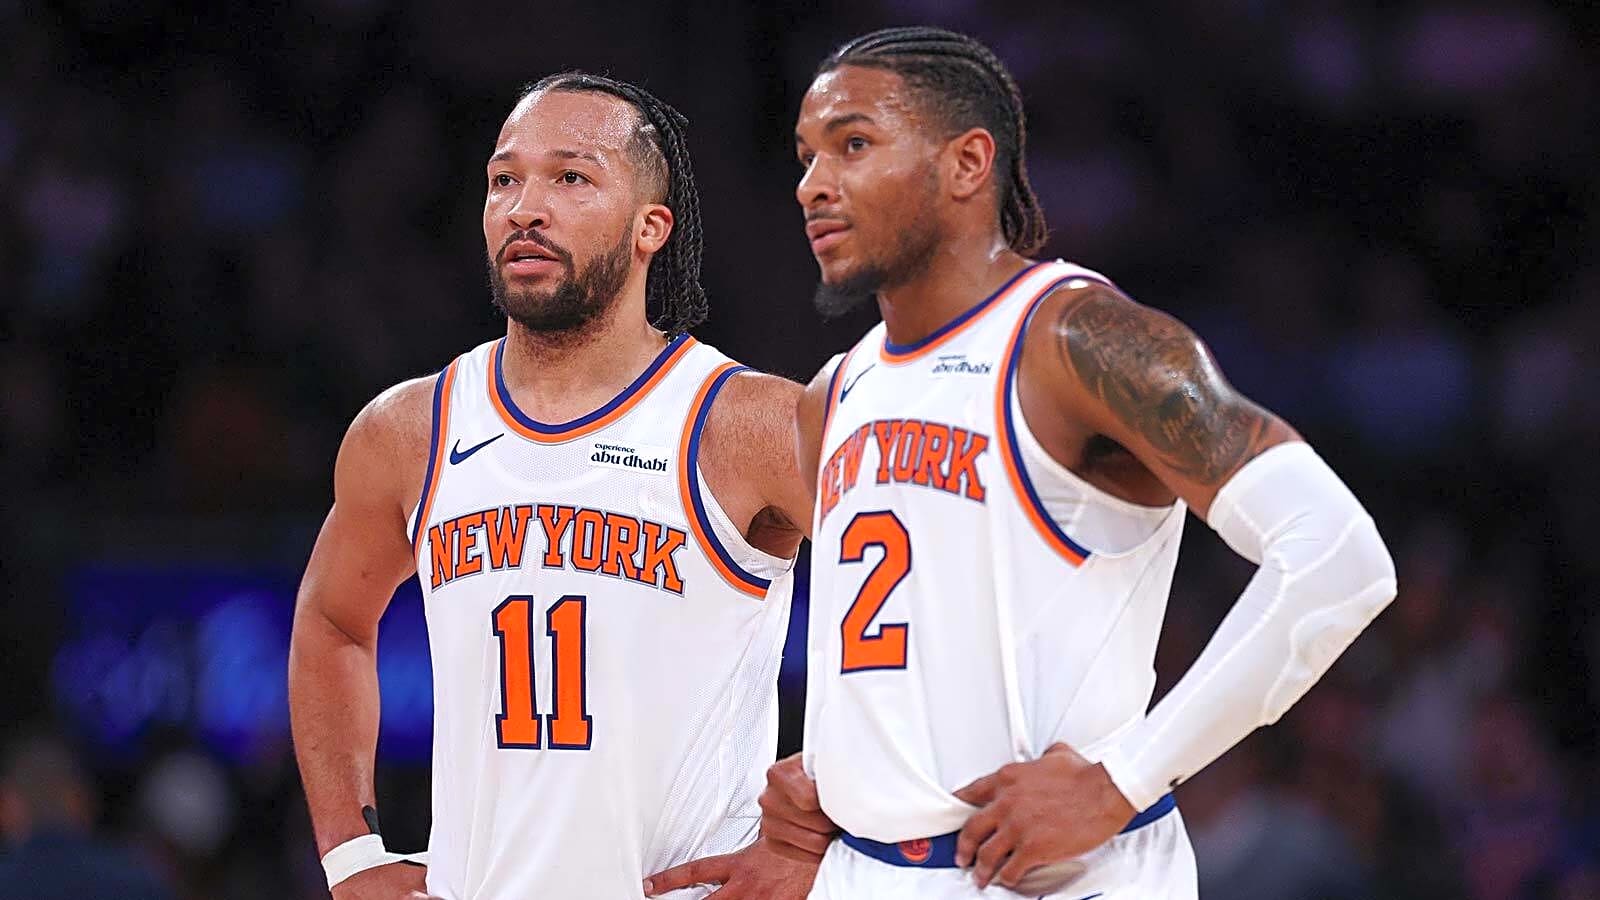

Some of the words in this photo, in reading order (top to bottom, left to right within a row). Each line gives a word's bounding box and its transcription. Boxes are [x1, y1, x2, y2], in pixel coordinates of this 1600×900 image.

[591, 451, 621, 464] abu
[623, 455, 668, 471] dhabi
[594, 443, 635, 453] experience
[873, 418, 991, 505] YORK
[428, 503, 533, 593] NEW
[536, 503, 688, 597] YORK
[838, 509, 912, 675] 2
[491, 594, 593, 751] 11
